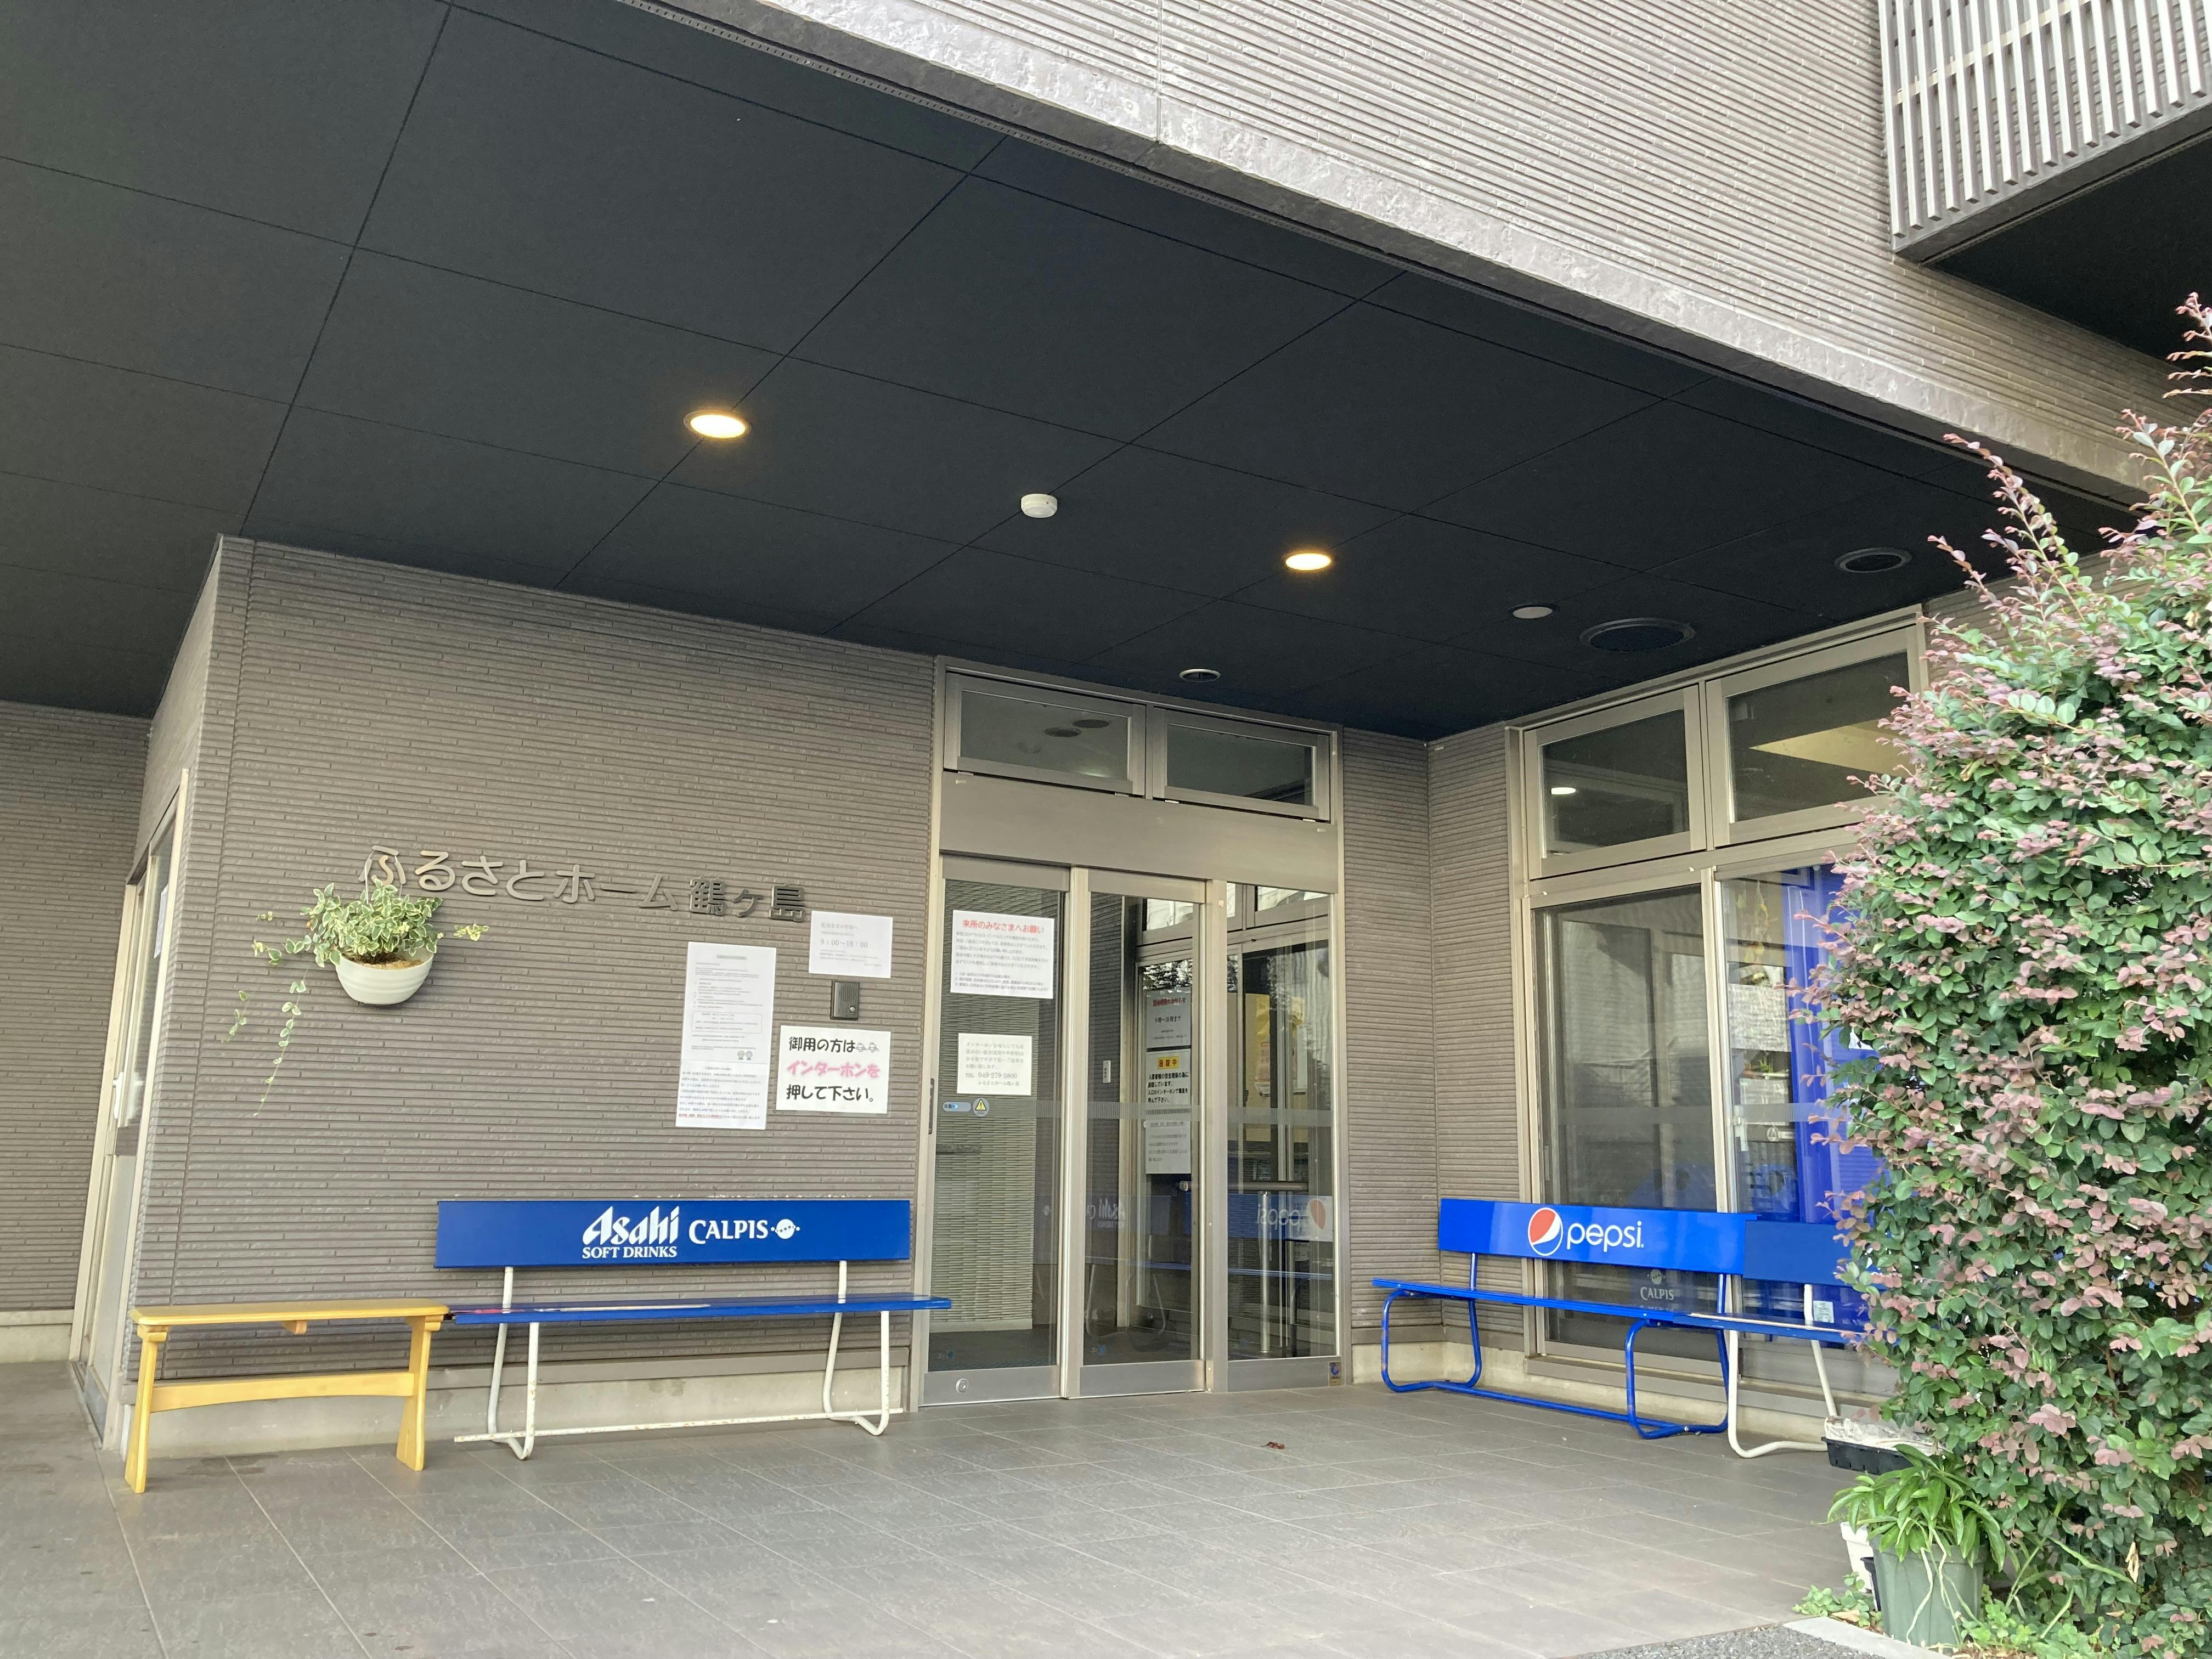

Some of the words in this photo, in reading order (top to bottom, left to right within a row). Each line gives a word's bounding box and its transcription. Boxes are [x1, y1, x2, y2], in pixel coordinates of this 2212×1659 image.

[962, 919, 1045, 934] 来所のみなさまへお願い
[789, 1036, 856, 1053] 御用の方は
[786, 1060, 881, 1079] インターホンを
[786, 1084, 874, 1103] 押して下さい。
[582, 1206, 680, 1245] Asahi
[689, 1219, 769, 1244] CALPIS
[1567, 1221, 1642, 1252] pepsi
[582, 1246, 620, 1259] SOFT
[623, 1246, 677, 1258] DRINKS
[1640, 1286, 1674, 1300] CALPIS
